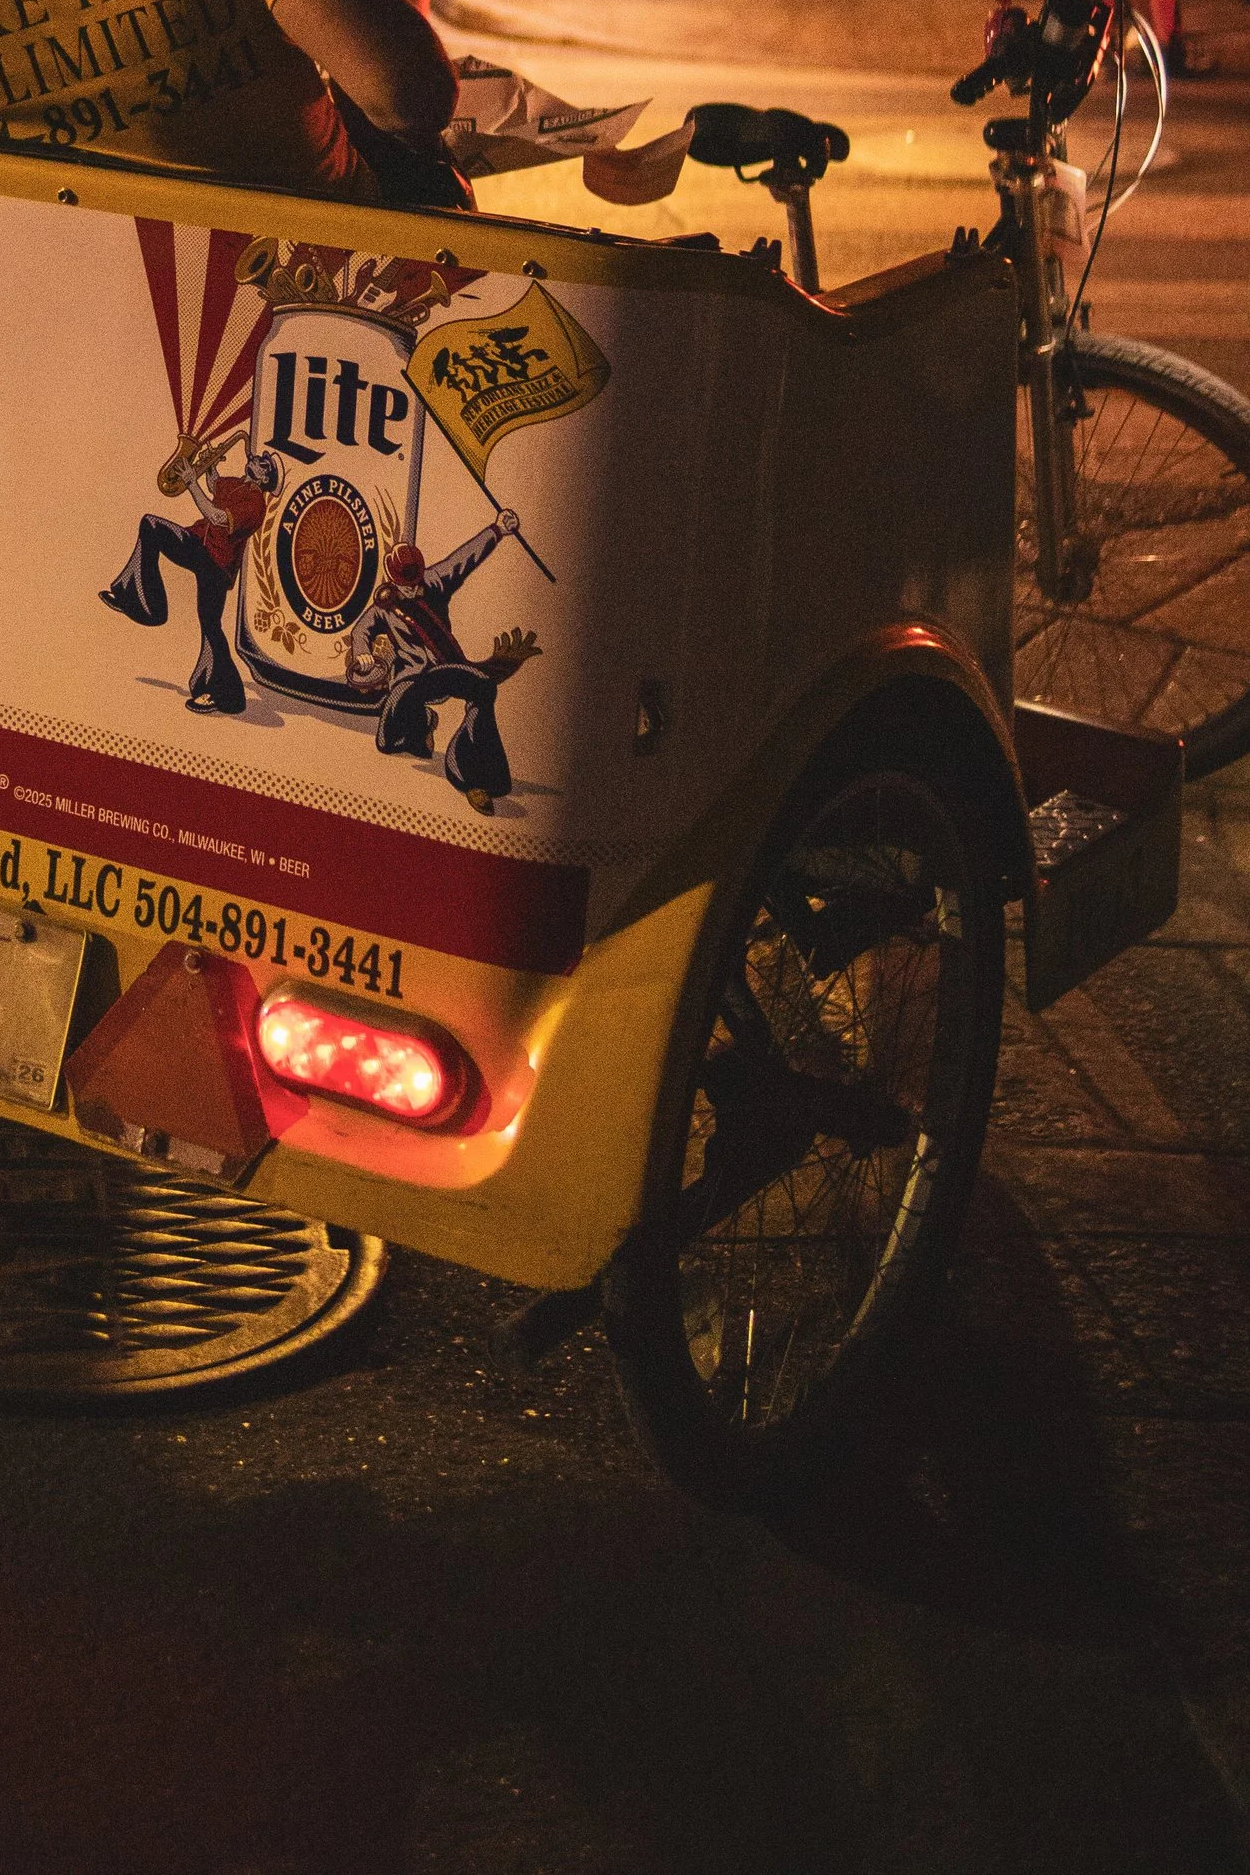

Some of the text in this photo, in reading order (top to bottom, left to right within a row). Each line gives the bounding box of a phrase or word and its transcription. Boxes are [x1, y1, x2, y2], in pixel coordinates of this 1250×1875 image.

[265, 351, 409, 464] Lite
[463, 401, 483, 424] NEW
[481, 384, 527, 403] ORLEANS
[525, 376, 550, 392] JAZZ
[472, 383, 572, 440] HERITAGE FESTIVAL
[283, 478, 375, 552] A FINE PILSNER
[301, 607, 345, 630] BEER
[13, 785, 310, 879] ©2025 MILLER BREWING CO., MILWAUKEE, WI BEER
[43, 847, 123, 918] LLC
[134, 880, 406, 1000] 504-891-3441
